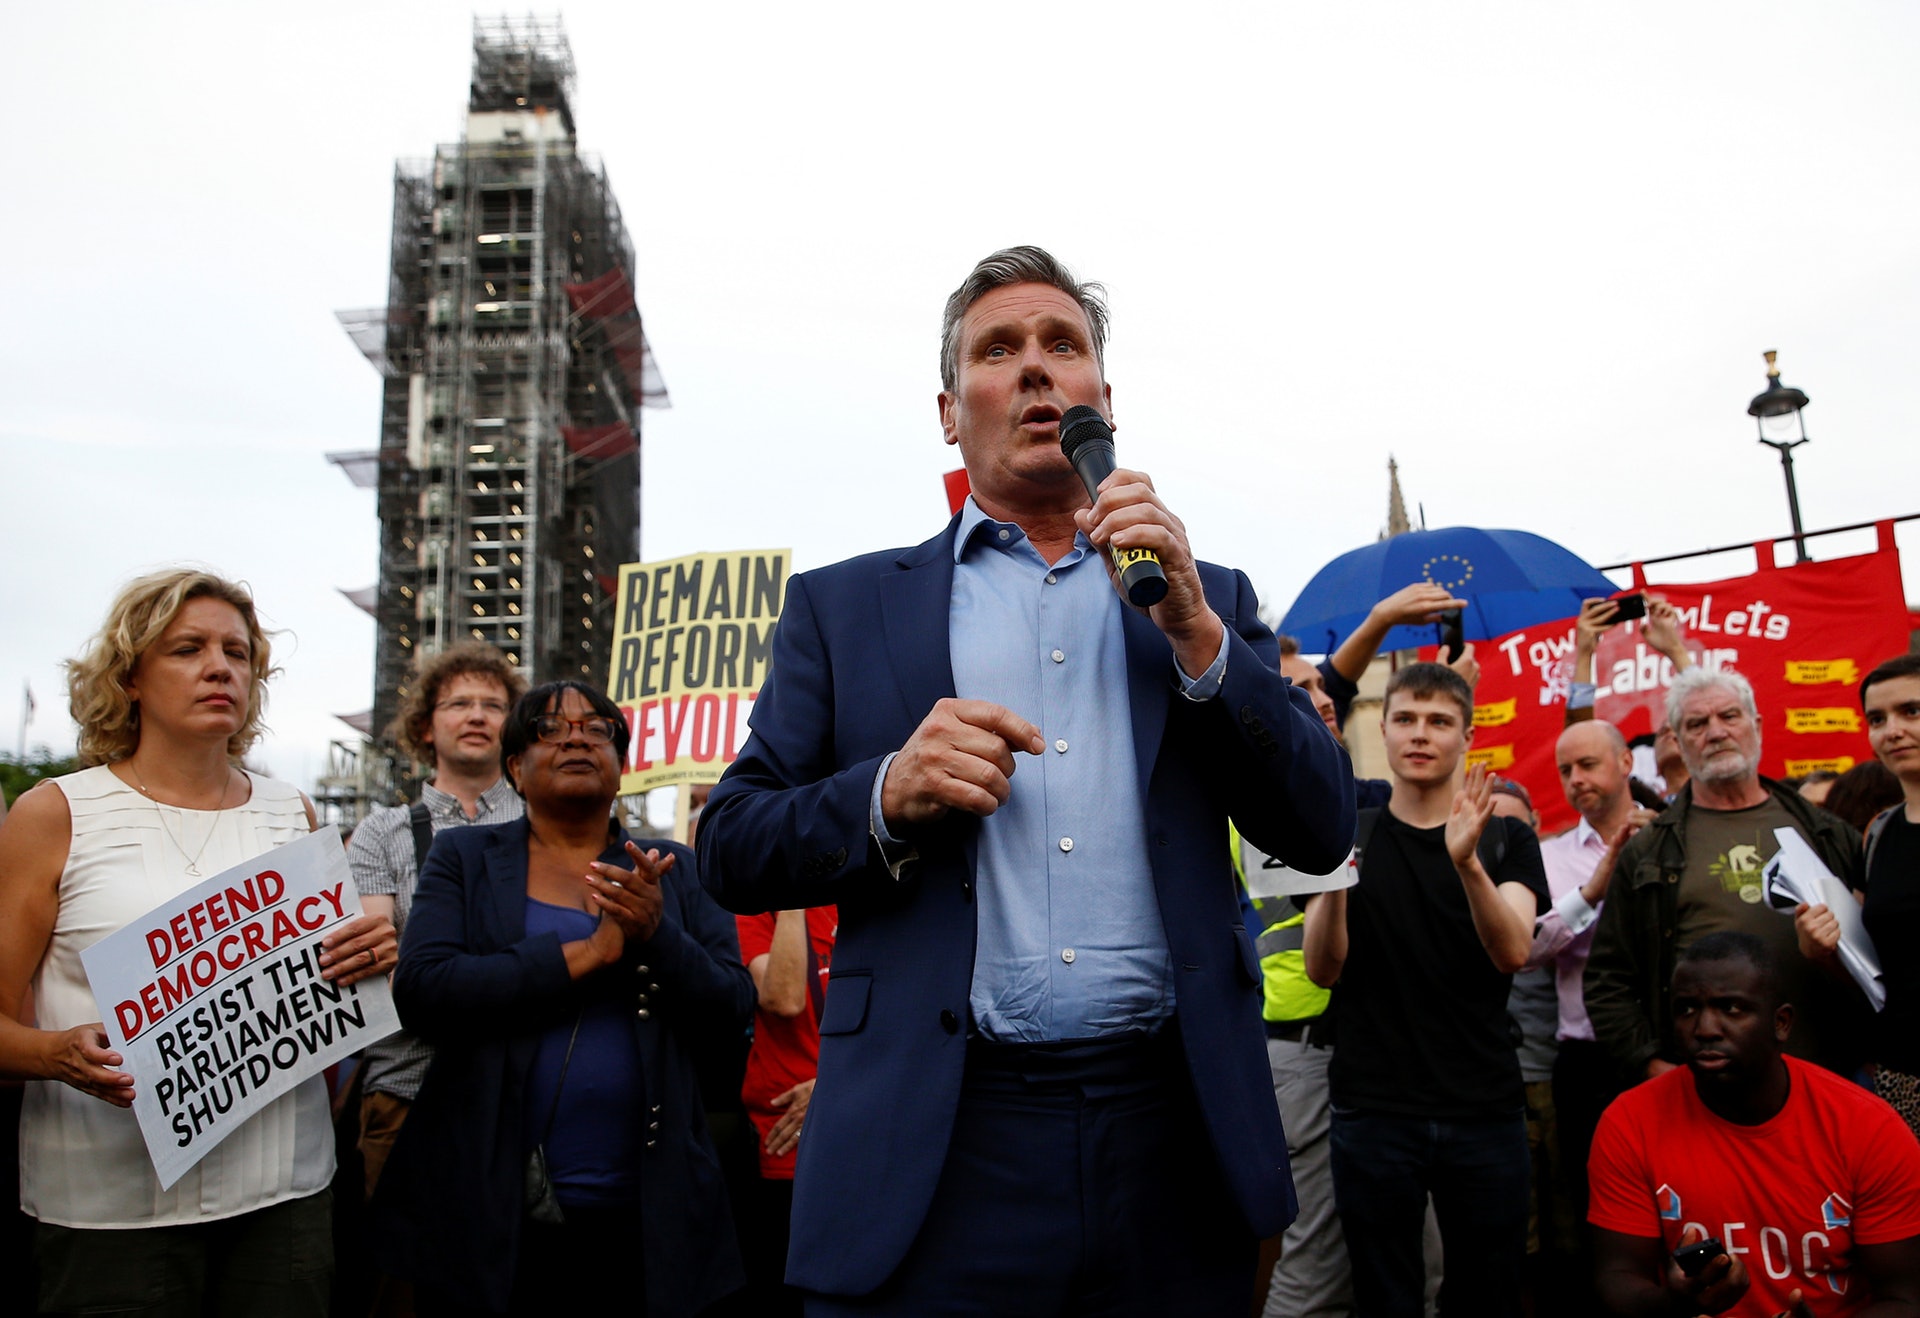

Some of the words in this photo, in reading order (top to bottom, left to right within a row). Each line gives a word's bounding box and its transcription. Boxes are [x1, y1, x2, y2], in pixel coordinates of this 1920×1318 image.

[623, 556, 783, 634] REMAIN
[615, 622, 776, 702] REFORM
[619, 691, 758, 775] EVOL
[114, 882, 344, 1042] DEMOCRACY
[145, 870, 285, 968] DEFEND
[155, 976, 255, 1070] RESIST
[171, 999, 367, 1148] SHUTDOWN
